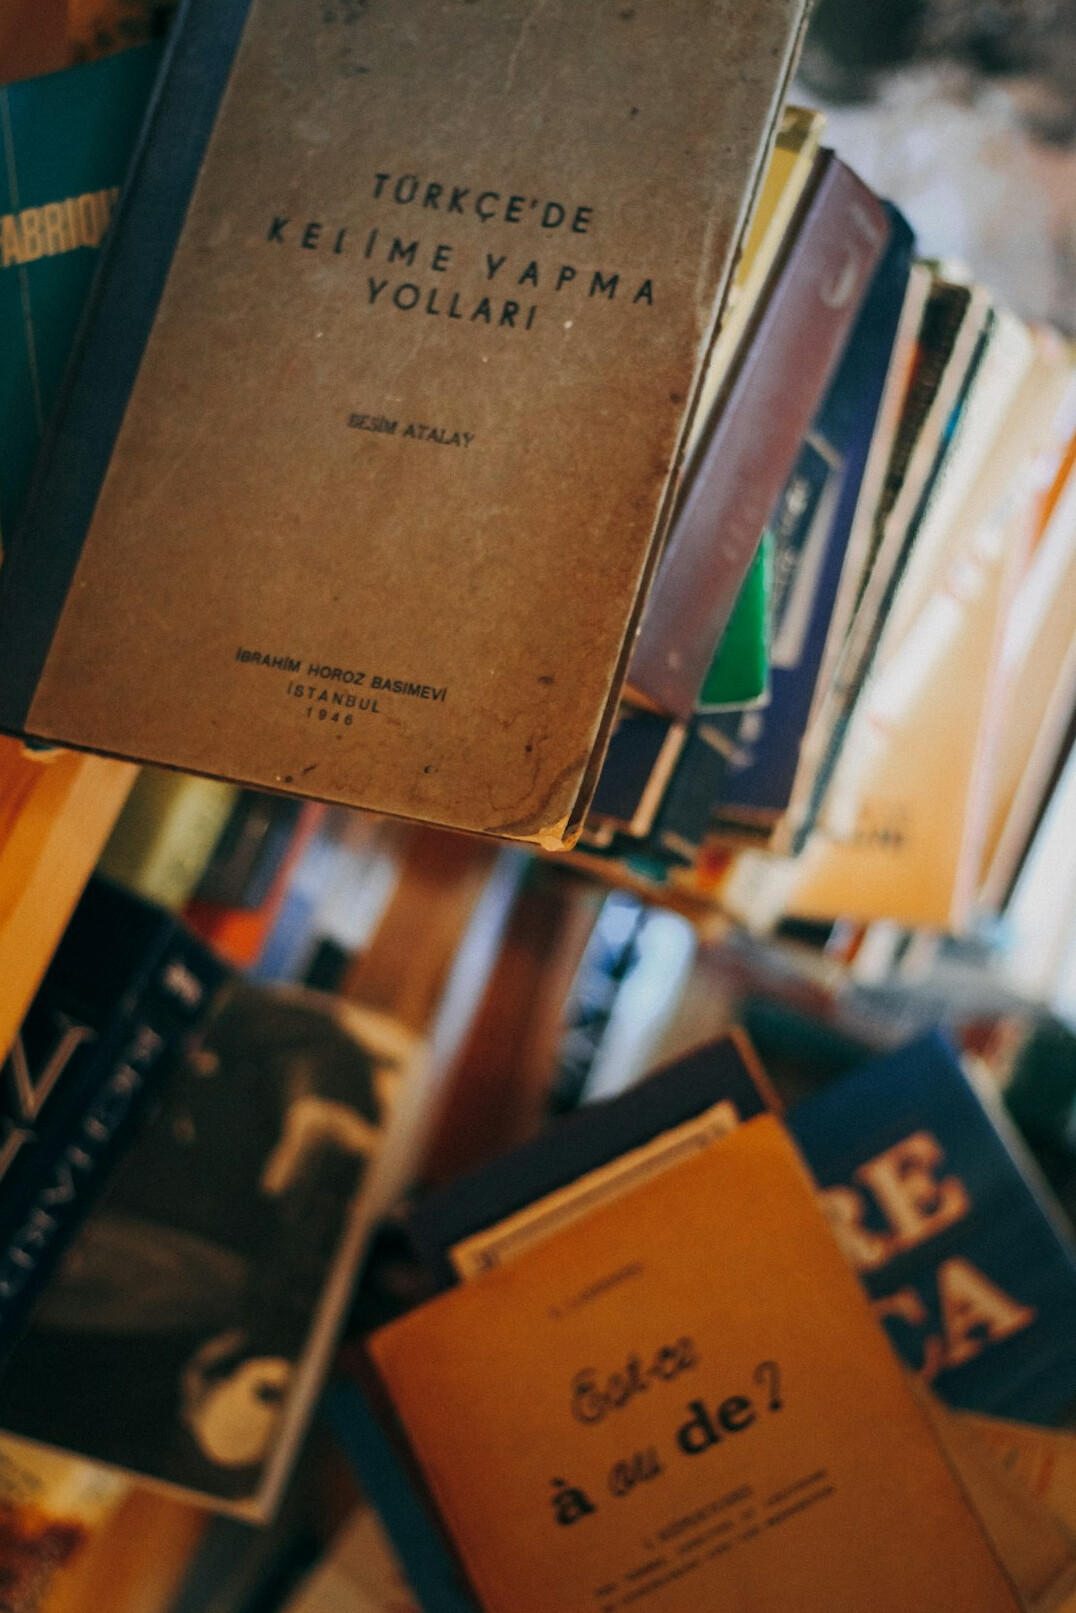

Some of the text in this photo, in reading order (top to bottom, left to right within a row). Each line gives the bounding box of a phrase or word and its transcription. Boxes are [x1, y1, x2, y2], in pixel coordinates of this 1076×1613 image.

[373, 172, 594, 234] TÜRKÇE'DE
[367, 276, 538, 331] YOLLARI
[485, 252, 655, 306] YAPMA
[401, 421, 475, 449] ATALAY
[235, 647, 447, 704] İBRAHİM HOROZ BASIMEVİ
[286, 681, 380, 714] İSTANBUL
[306, 706, 354, 726] 1946
